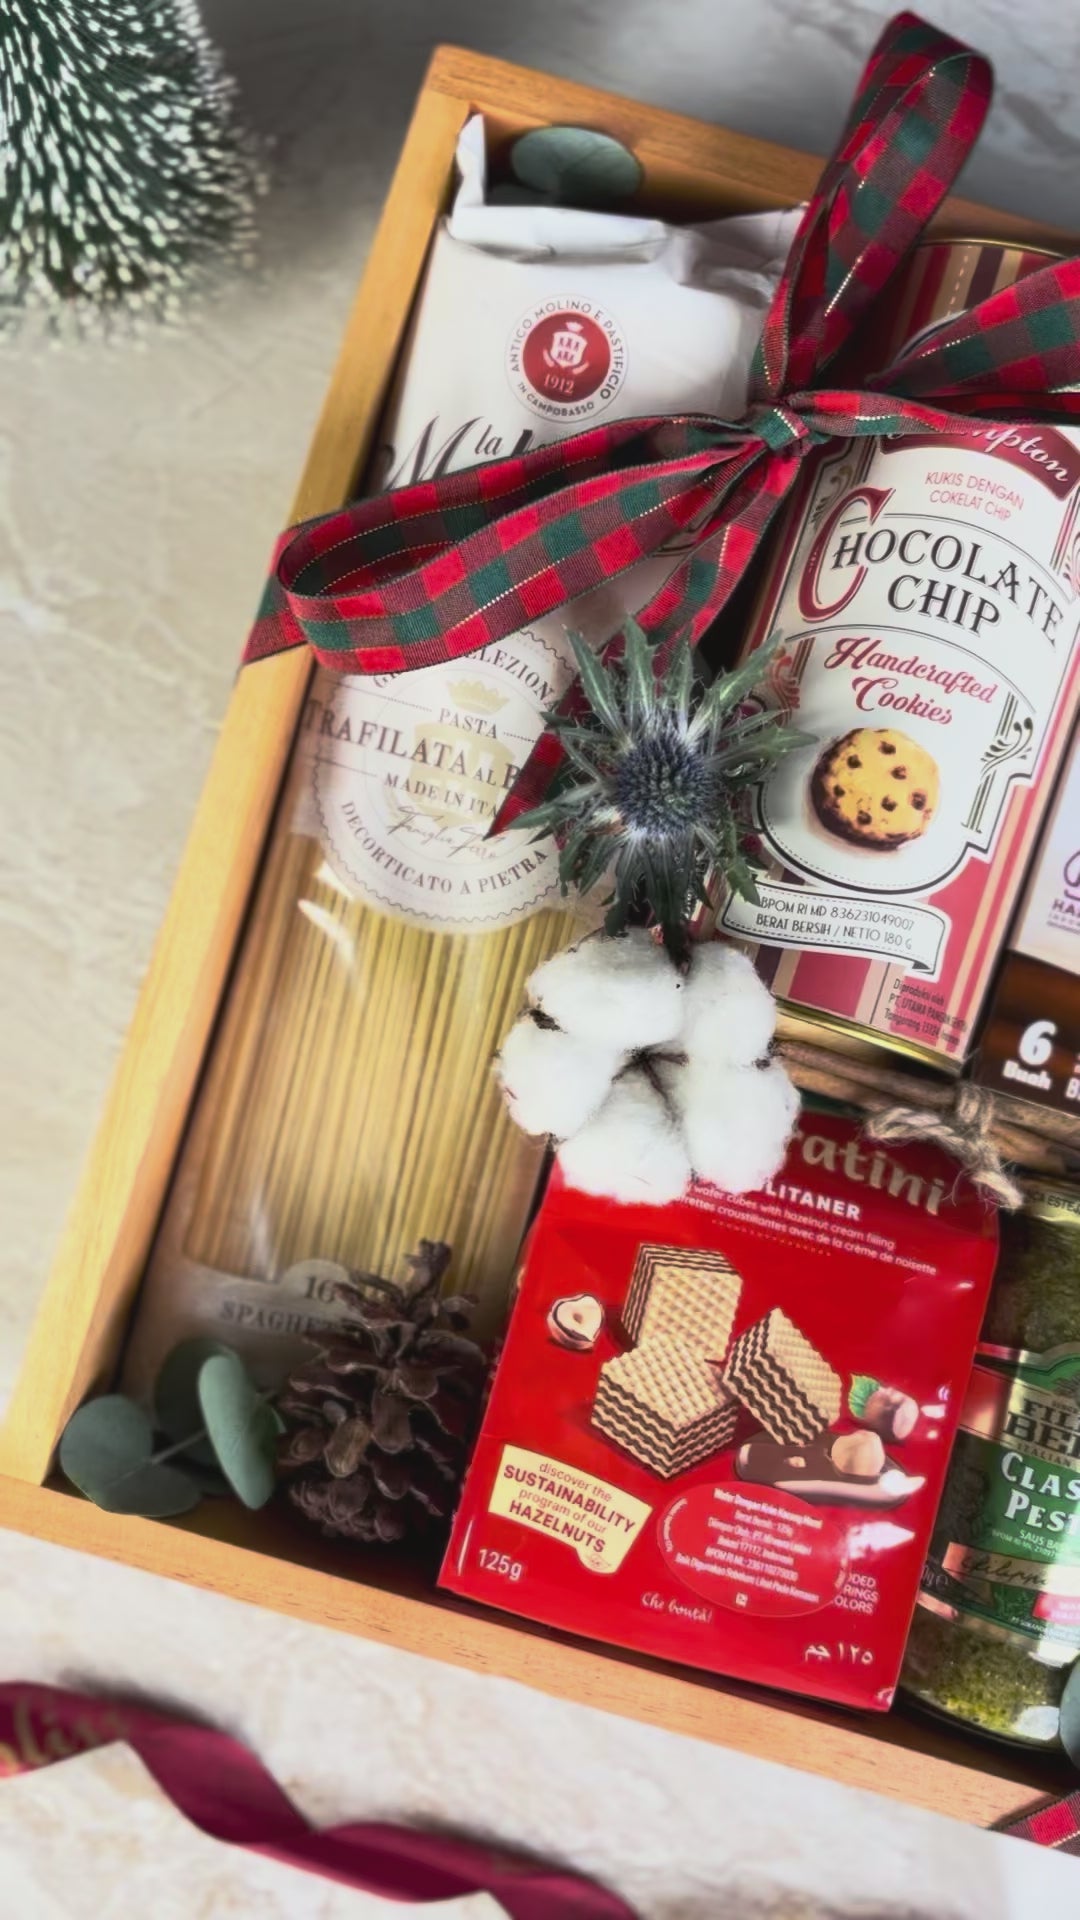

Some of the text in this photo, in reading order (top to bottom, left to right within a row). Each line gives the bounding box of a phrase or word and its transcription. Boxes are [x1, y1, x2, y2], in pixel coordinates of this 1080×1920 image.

[510, 299, 624, 400] ANTICO MOLINO E PASTIFICIO
[518, 382, 595, 417] IN CAMPOBASSO
[544, 373, 575, 395] 1912
[971, 427, 1068, 482] pton
[925, 471, 1024, 511] KUKIS DENGAN
[929, 489, 1012, 520] COKELAT CHIP
[798, 487, 1064, 647] CHOCOLATE
[888, 574, 1001, 638] CHIP
[466, 649, 556, 712] LEZION
[824, 636, 998, 704] Handcrafted
[439, 708, 498, 739] PASTA
[851, 676, 953, 725] Cookies
[303, 698, 467, 777] TRAFILATA
[472, 766, 497, 787] AL
[384, 772, 497, 818] MADE IN ITA
[341, 801, 549, 896] DECORTICATO A PIETRA
[756, 913, 789, 927] BERAT
[792, 919, 832, 936] BERSIH
[843, 925, 881, 941] NETTO
[884, 931, 903, 946] 180
[760, 896, 916, 932] BPOM RI MD 836231049007
[1018, 1020, 1057, 1067] 6
[798, 1133, 945, 1217] atini
[694, 1184, 725, 1200] wafer
[726, 1193, 758, 1210] cubes
[759, 1203, 783, 1217] with
[783, 1208, 829, 1230] hazelnut
[830, 1222, 865, 1241] cream
[765, 1180, 861, 1221] LITANER
[681, 1196, 717, 1212] rettes
[717, 1205, 788, 1233] croustillantes
[788, 1225, 815, 1241] avec
[816, 1232, 831, 1245] de
[832, 1236, 843, 1249] la
[879, 1250, 894, 1263] de
[895, 1256, 938, 1276] noisette
[503, 1463, 637, 1535] SUSTAINABILITY
[539, 1462, 614, 1503] discover the
[508, 1498, 607, 1554] HAZELNUTS
[518, 1488, 607, 1535] program of our
[479, 1548, 523, 1582] 125g
[849, 1572, 876, 1588] DED
[834, 1595, 874, 1615] OLORS
[843, 1584, 879, 1604] RINGS
